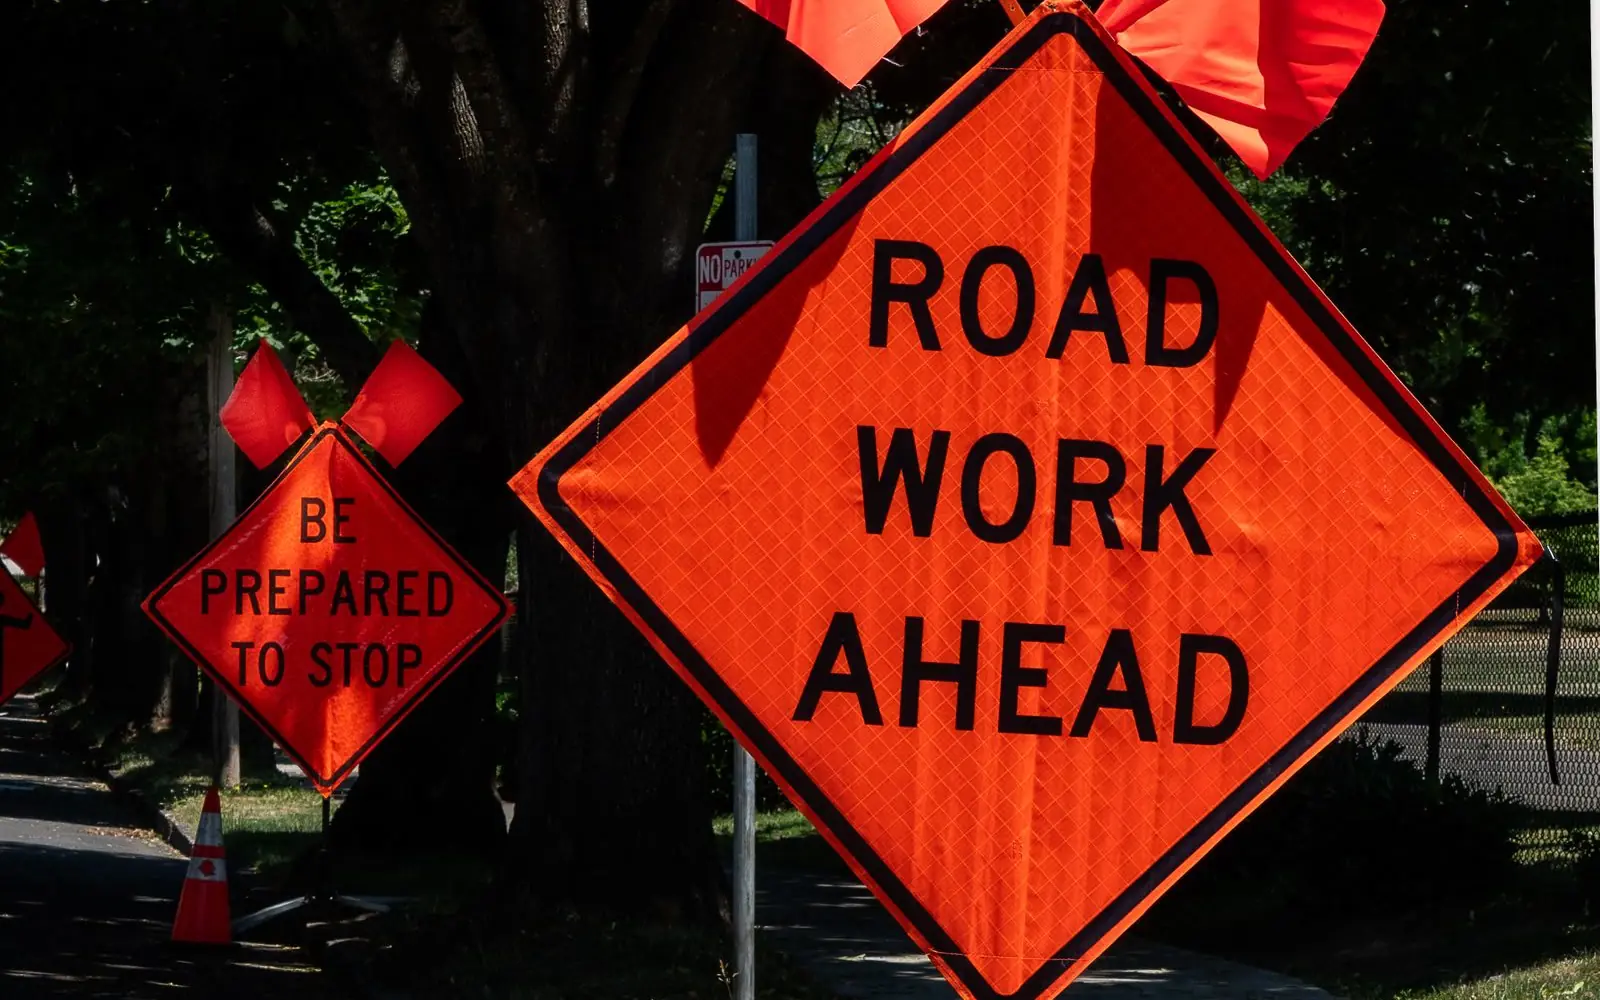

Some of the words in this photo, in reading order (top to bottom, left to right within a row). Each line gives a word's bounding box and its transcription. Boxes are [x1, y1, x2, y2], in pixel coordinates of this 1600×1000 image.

[700, 254, 721, 284] NO
[869, 239, 1221, 368] ROAD
[857, 425, 1217, 556] WORK
[299, 497, 358, 545] BE
[200, 568, 455, 618] PREPARED
[231, 641, 286, 687] TO
[307, 641, 423, 689] STOP
[792, 611, 1250, 746] AHEAD
